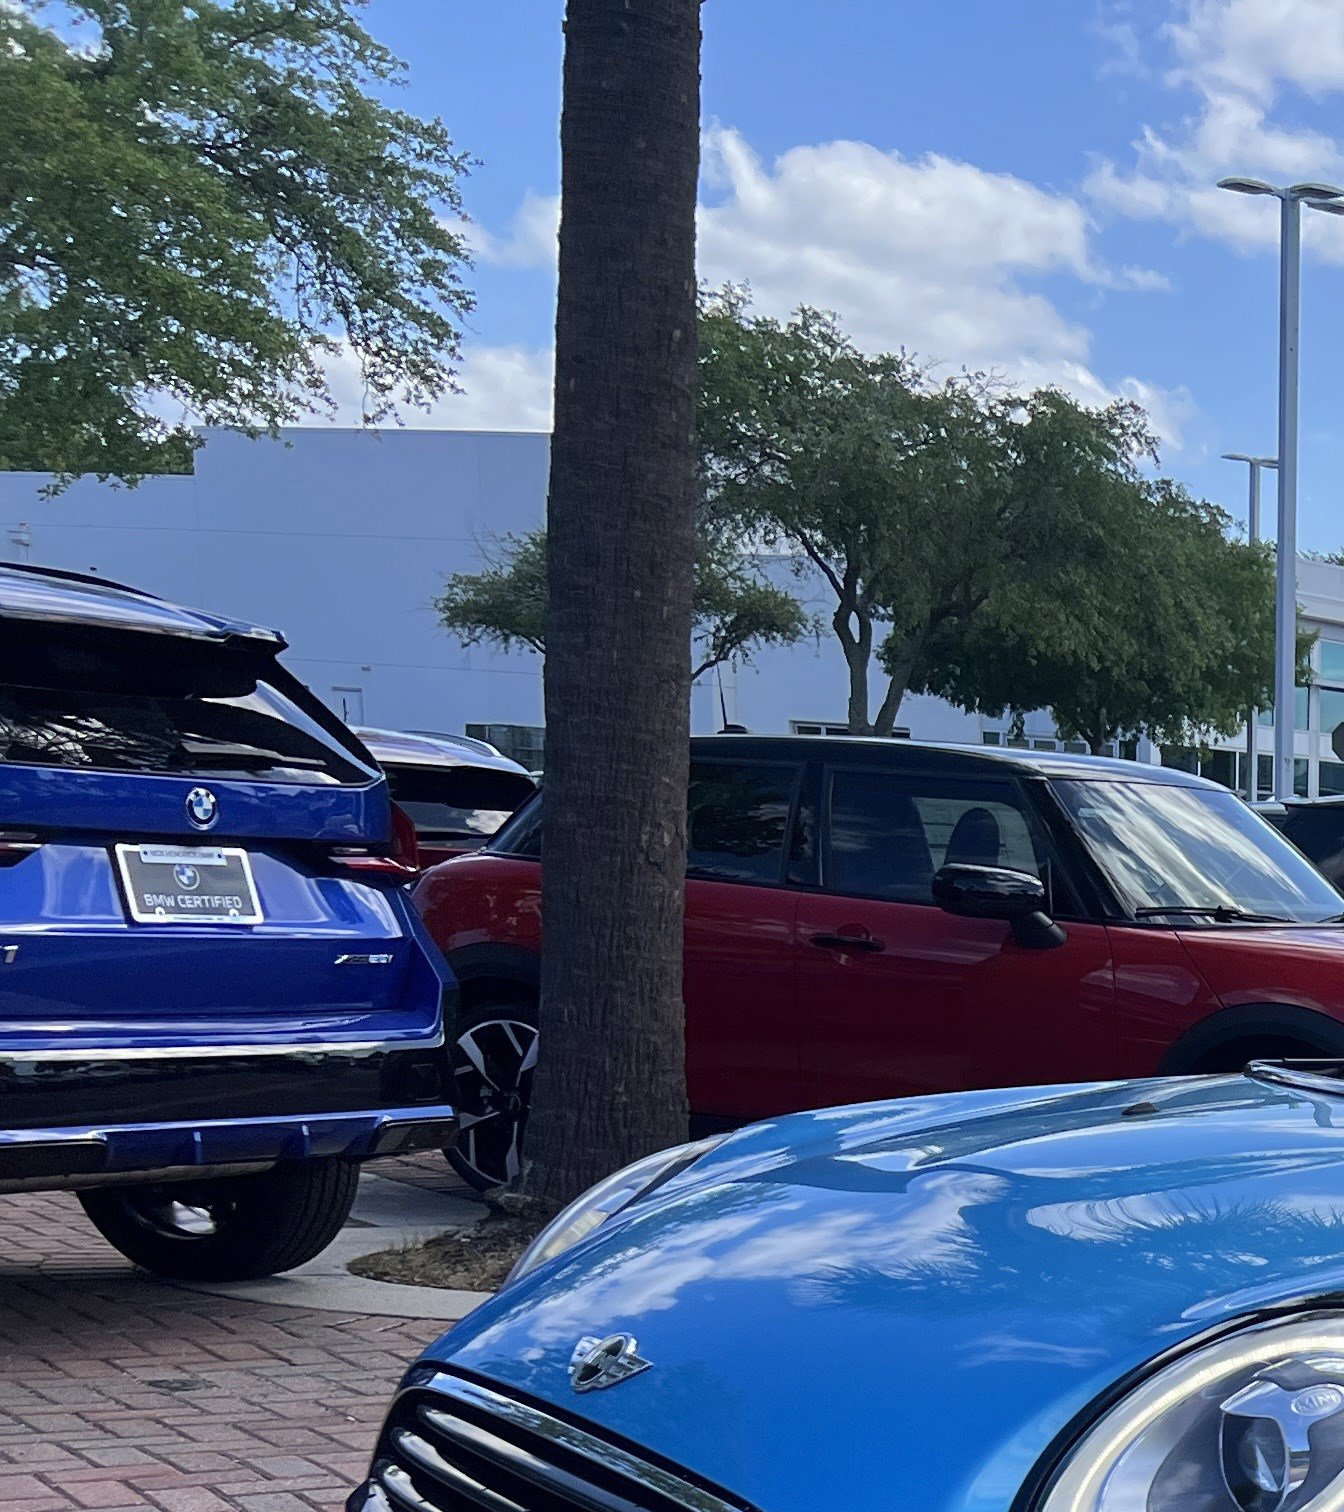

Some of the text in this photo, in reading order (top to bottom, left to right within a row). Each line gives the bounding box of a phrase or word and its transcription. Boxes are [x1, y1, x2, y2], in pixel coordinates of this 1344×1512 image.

[143, 893, 243, 909] BMW CERTIFIED
[1295, 1393, 1339, 1412] MINI
